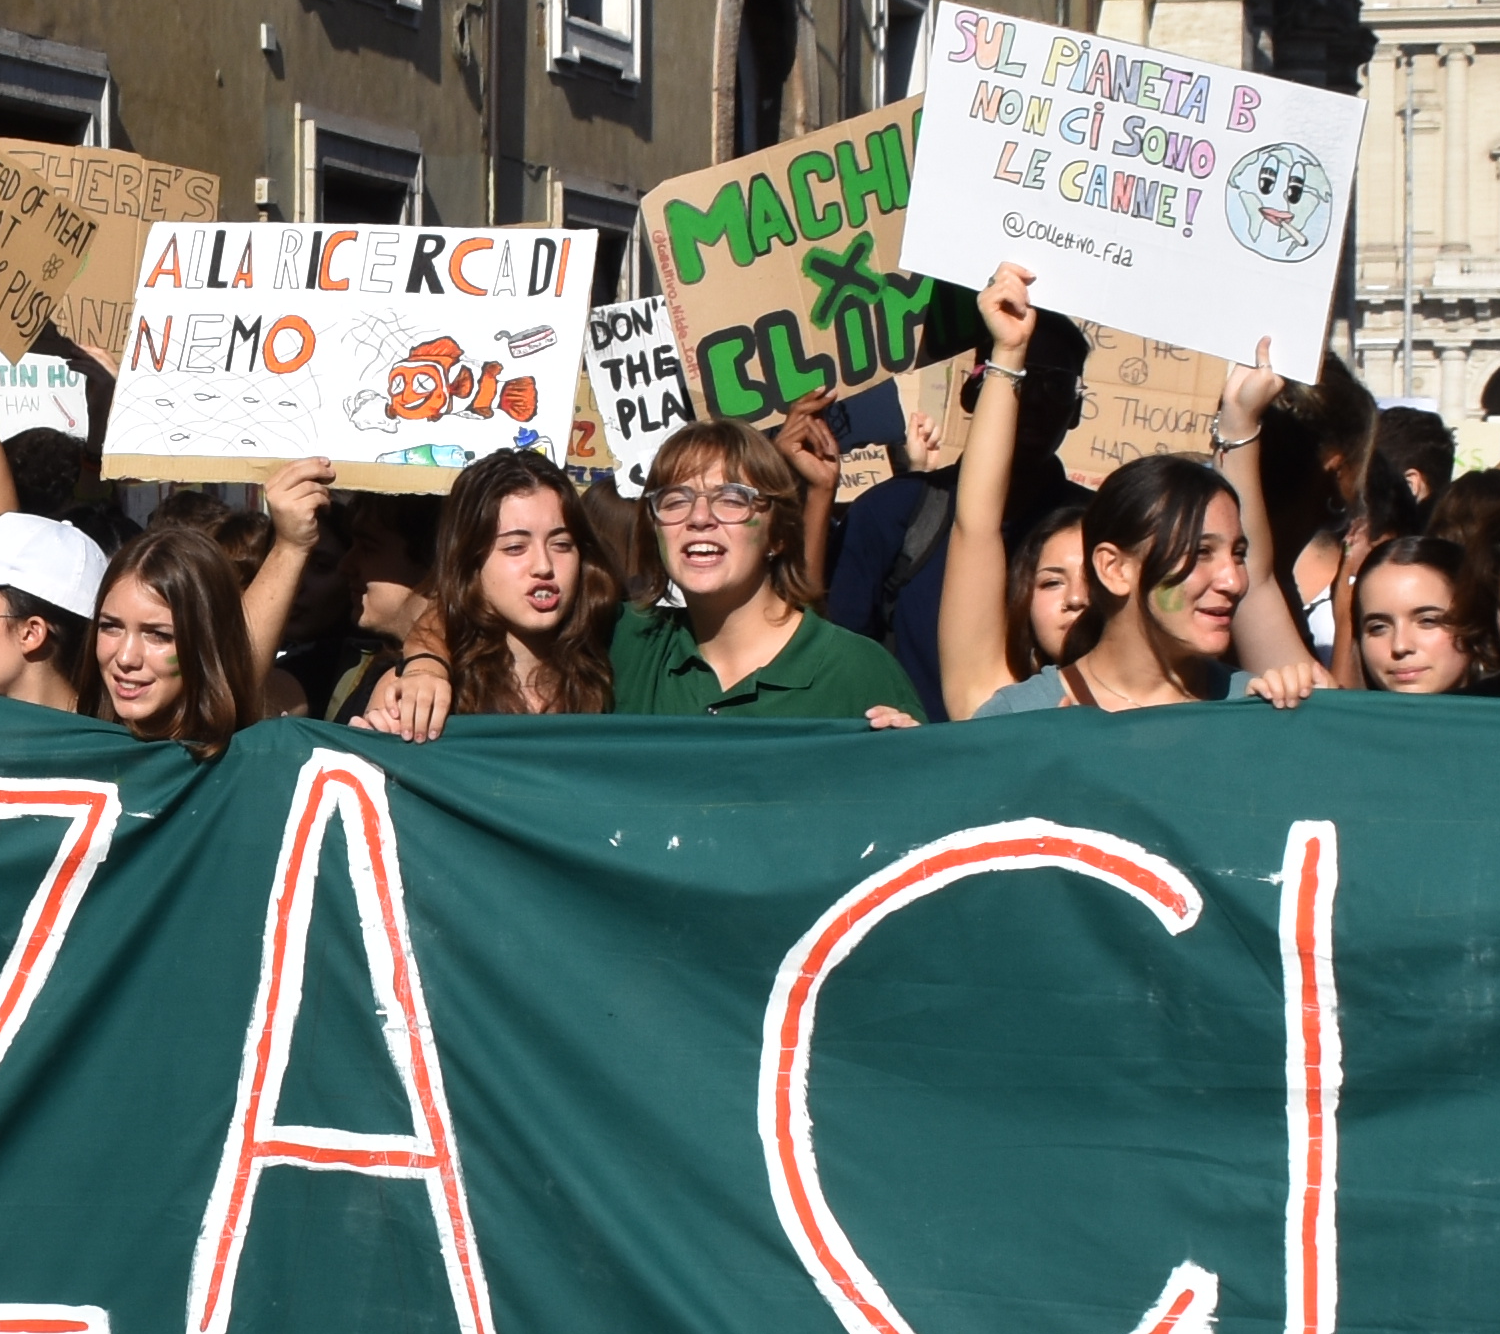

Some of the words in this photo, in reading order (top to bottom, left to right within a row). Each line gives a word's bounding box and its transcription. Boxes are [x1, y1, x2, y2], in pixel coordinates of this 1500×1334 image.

[948, 10, 1027, 78] SUL
[1226, 85, 1261, 133] B
[970, 81, 1052, 136] NON
[1112, 115, 1216, 179] SONO
[20, 185, 50, 218] OF
[44, 201, 98, 259] MEAT
[663, 108, 923, 285] MACHI
[993, 141, 1051, 190] LE
[1059, 160, 1203, 238] CANNE!
[144, 229, 253, 290] ALLA
[273, 228, 518, 298] RICERCA
[527, 236, 572, 298] DI
[131, 314, 317, 375] NEMO
[590, 296, 666, 351] DON'
[696, 273, 980, 427] CLIM
[600, 344, 678, 392] THE
[616, 388, 689, 441] PLA
[838, 470, 881, 489] ANET
[841, 448, 885, 464] EWING
